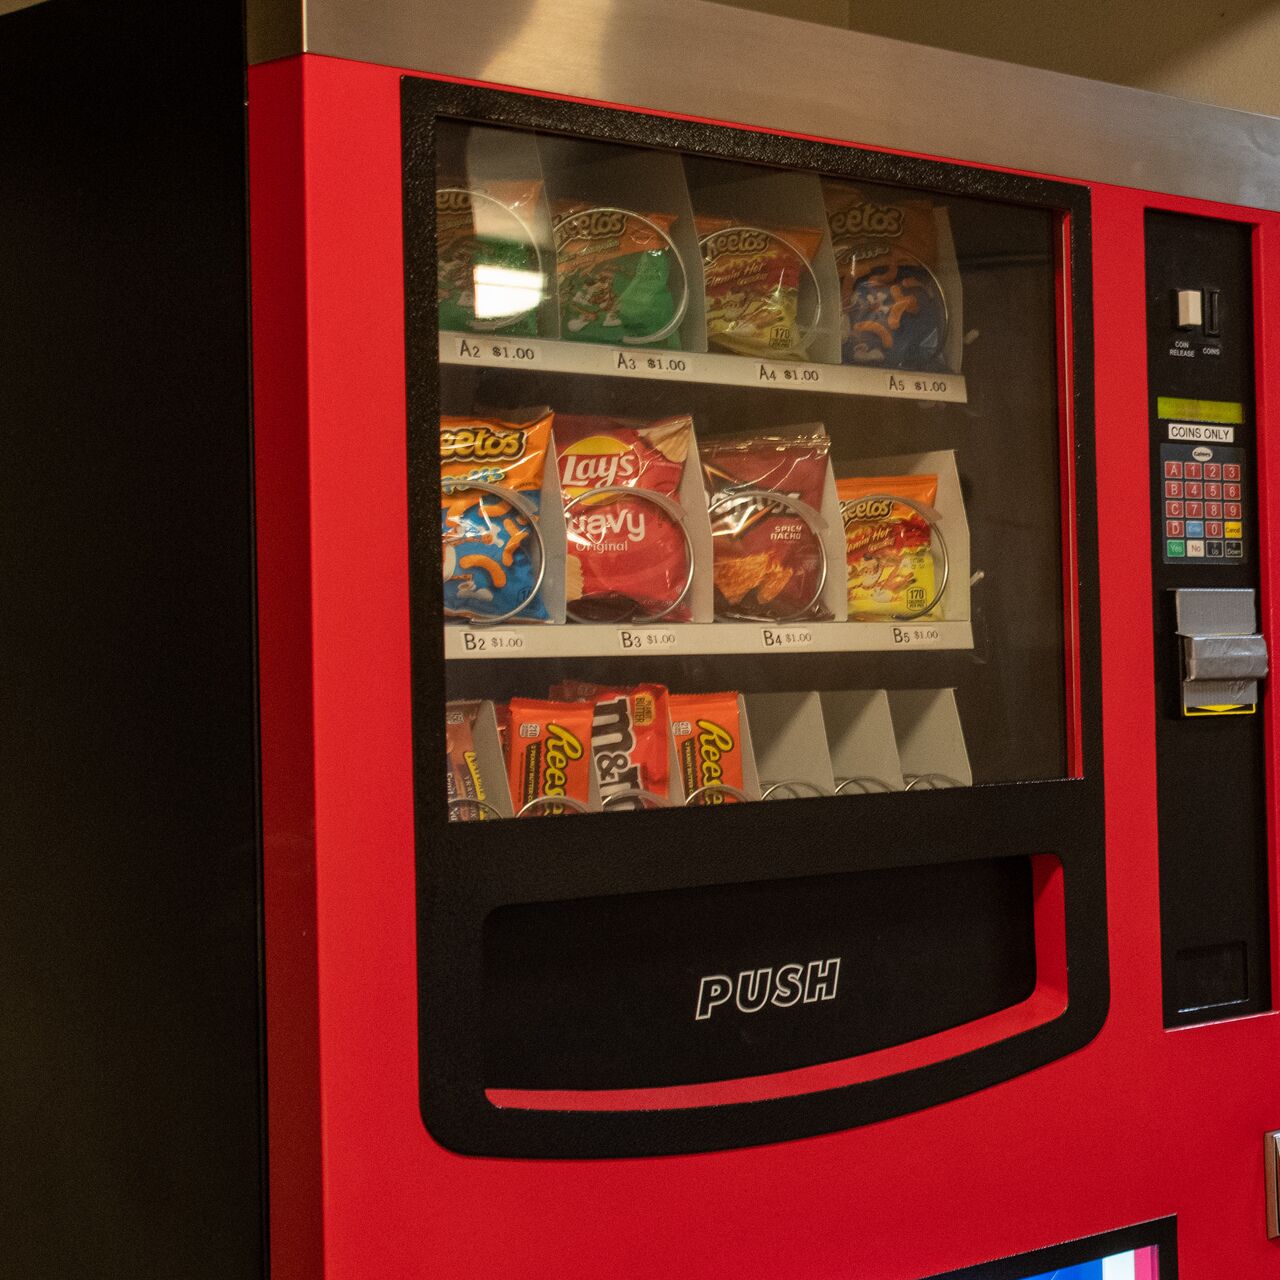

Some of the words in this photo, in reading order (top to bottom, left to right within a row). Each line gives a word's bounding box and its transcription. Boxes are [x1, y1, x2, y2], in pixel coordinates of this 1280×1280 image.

[831, 204, 900, 234] eetos
[704, 232, 767, 258] heetos
[460, 340, 481, 358] A2
[492, 347, 535, 360] $1.00
[1174, 341, 1189, 349] COIN
[1169, 349, 1195, 357] RELEASE
[1202, 347, 1220, 356] COINS
[617, 353, 636, 370] A3
[648, 359, 686, 372] $1.00
[759, 365, 776, 381] A4
[784, 370, 819, 381] $1.00
[889, 376, 905, 391] A5
[915, 382, 947, 392] $1.00
[1171, 426, 1201, 438] COINS
[1203, 428, 1229, 440] ONLY
[440, 428, 520, 458] eetos
[562, 451, 635, 488] Lay's
[1170, 465, 1178, 476] A
[1190, 466, 1195, 476] 1
[1209, 467, 1216, 477] 2
[1229, 467, 1235, 478] 3
[1171, 484, 1178, 495] B
[1191, 485, 1197, 496] 4
[1210, 486, 1216, 497] 5
[1229, 487, 1235, 497] 6
[1171, 504, 1179, 515] C
[1191, 504, 1198, 515] 7
[1211, 505, 1217, 516] 8
[1230, 506, 1236, 516] 9
[774, 524, 803, 533] SPICY
[1172, 523, 1180, 535] D
[1211, 524, 1217, 535] 0
[1226, 526, 1240, 534] Cancel
[575, 541, 629, 554] Original
[1170, 545, 1182, 553] Yes
[1191, 545, 1200, 553] No
[910, 589, 925, 600] 170
[621, 631, 642, 648] B3
[646, 634, 676, 645] $1.00
[763, 630, 782, 647] B4
[785, 632, 812, 643] $1.00
[893, 628, 910, 644] B5
[914, 630, 938, 640] $1.00
[463, 633, 487, 651] B2
[491, 637, 523, 649] $1.00
[695, 958, 841, 1021] PUSH
